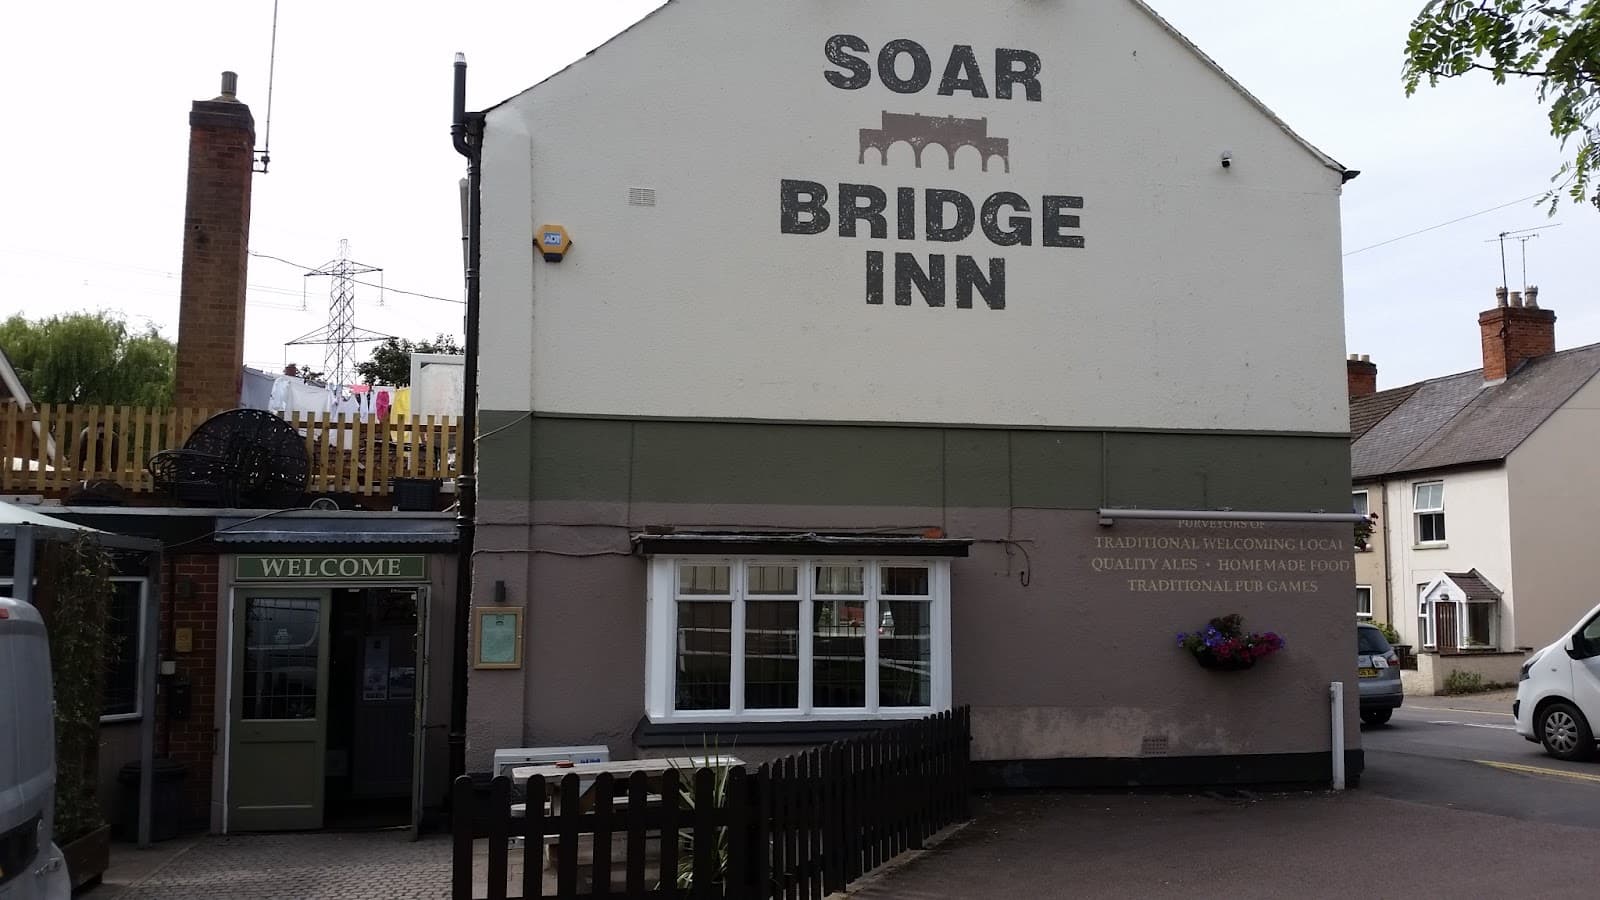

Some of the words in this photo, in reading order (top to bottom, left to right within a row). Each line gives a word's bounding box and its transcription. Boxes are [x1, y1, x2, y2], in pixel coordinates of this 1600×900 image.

[823, 34, 1042, 102] SOAR
[781, 179, 1085, 248] BRIDGE
[866, 250, 1006, 310] INN
[1095, 536, 1199, 550] TRADITIONAL
[1204, 538, 1296, 551] WELCOMING
[261, 558, 401, 577] WELCOME
[1091, 558, 1157, 571] QUALITY
[1161, 558, 1198, 571] ALES
[1218, 559, 1307, 572] HOMEMADE
[1311, 560, 1350, 572] FOOD
[1128, 579, 1233, 592] TRADITIONAL
[1235, 580, 1263, 592] PUB
[1267, 580, 1319, 593] GAMES
